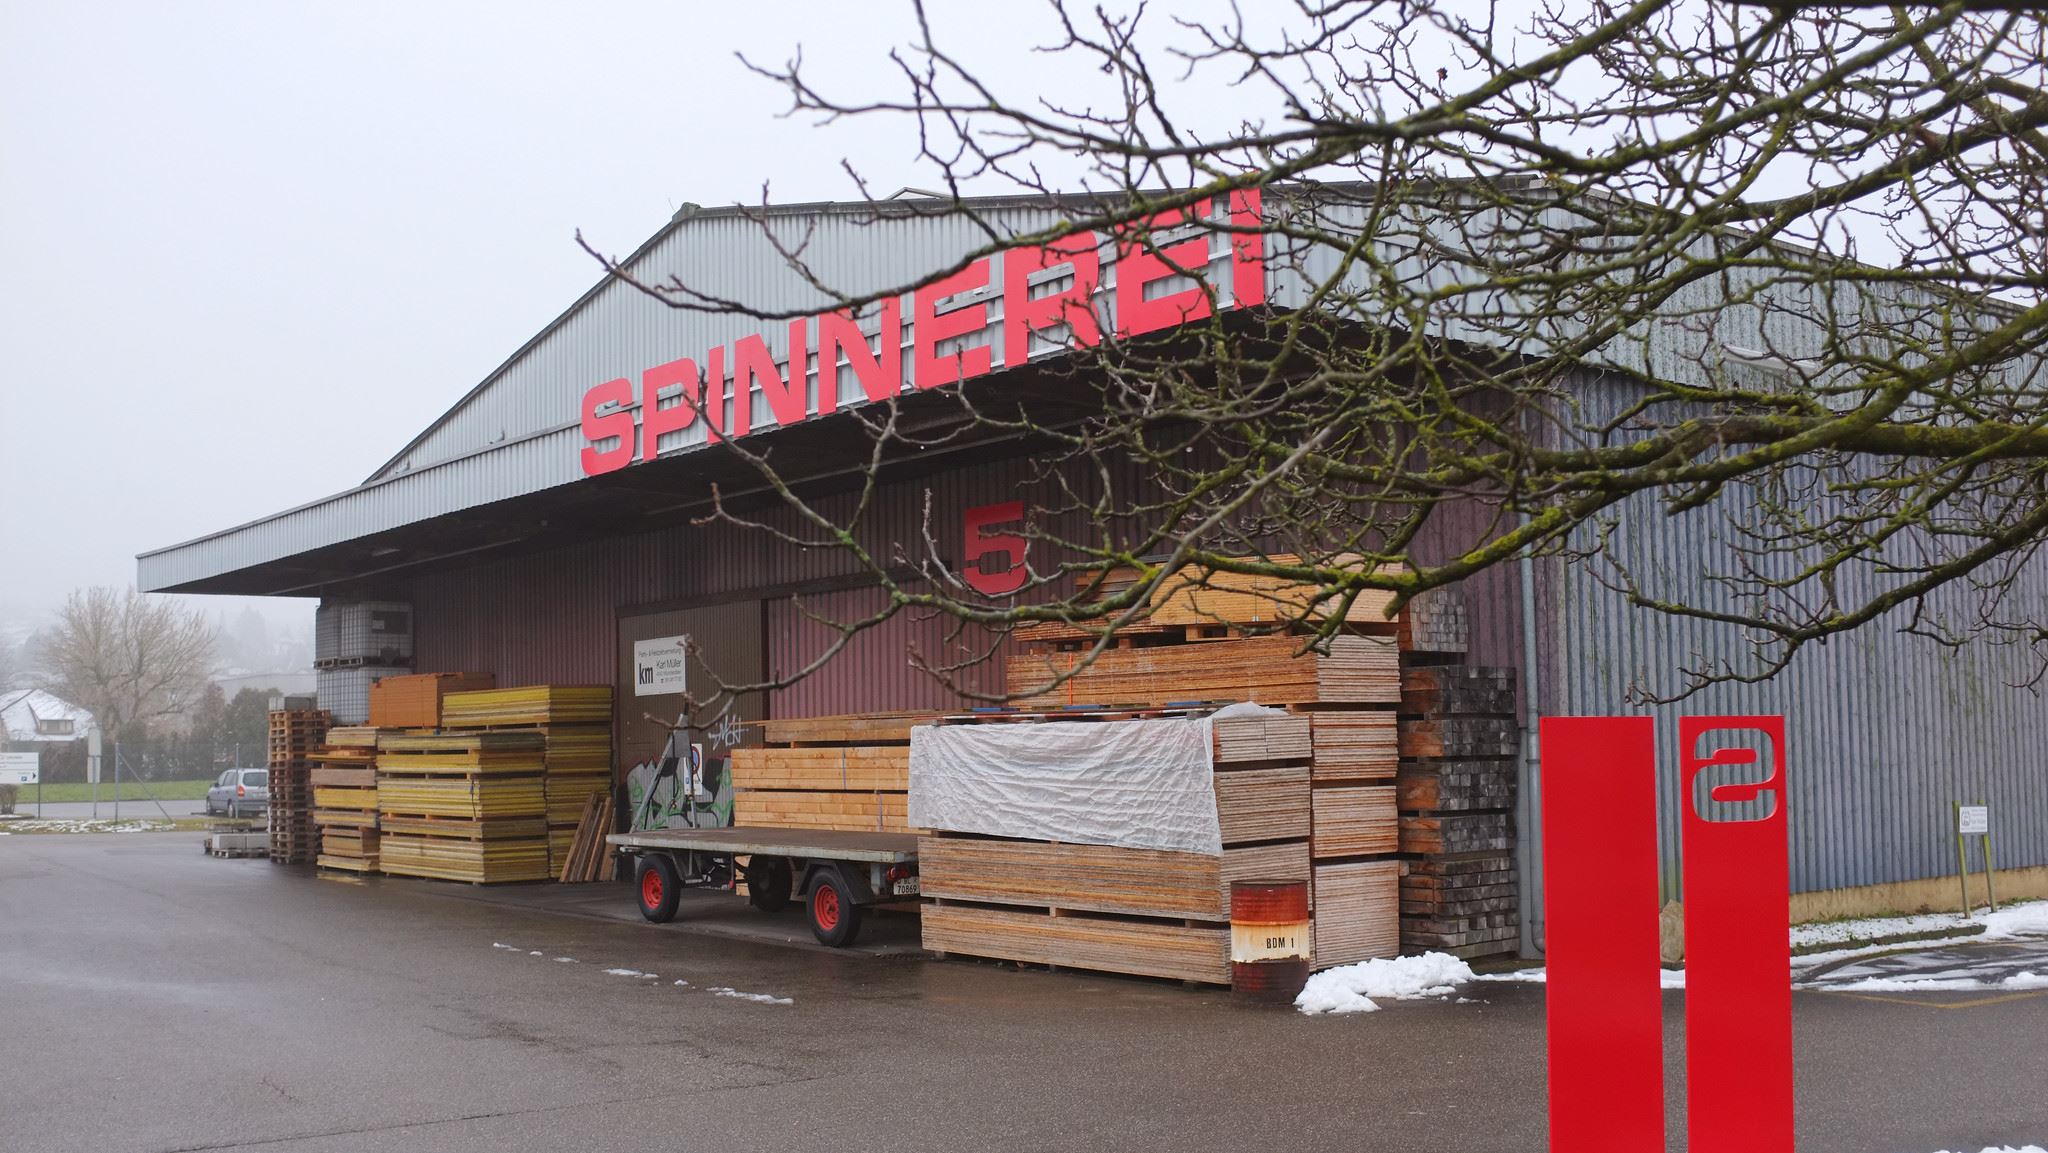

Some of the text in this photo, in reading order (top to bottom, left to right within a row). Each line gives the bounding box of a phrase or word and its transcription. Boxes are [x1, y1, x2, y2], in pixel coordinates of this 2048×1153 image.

[581, 171, 1266, 476] SPINNEREI
[963, 501, 1027, 594] 5
[639, 662, 654, 685] km
[1266, 937, 1285, 949] BDM
